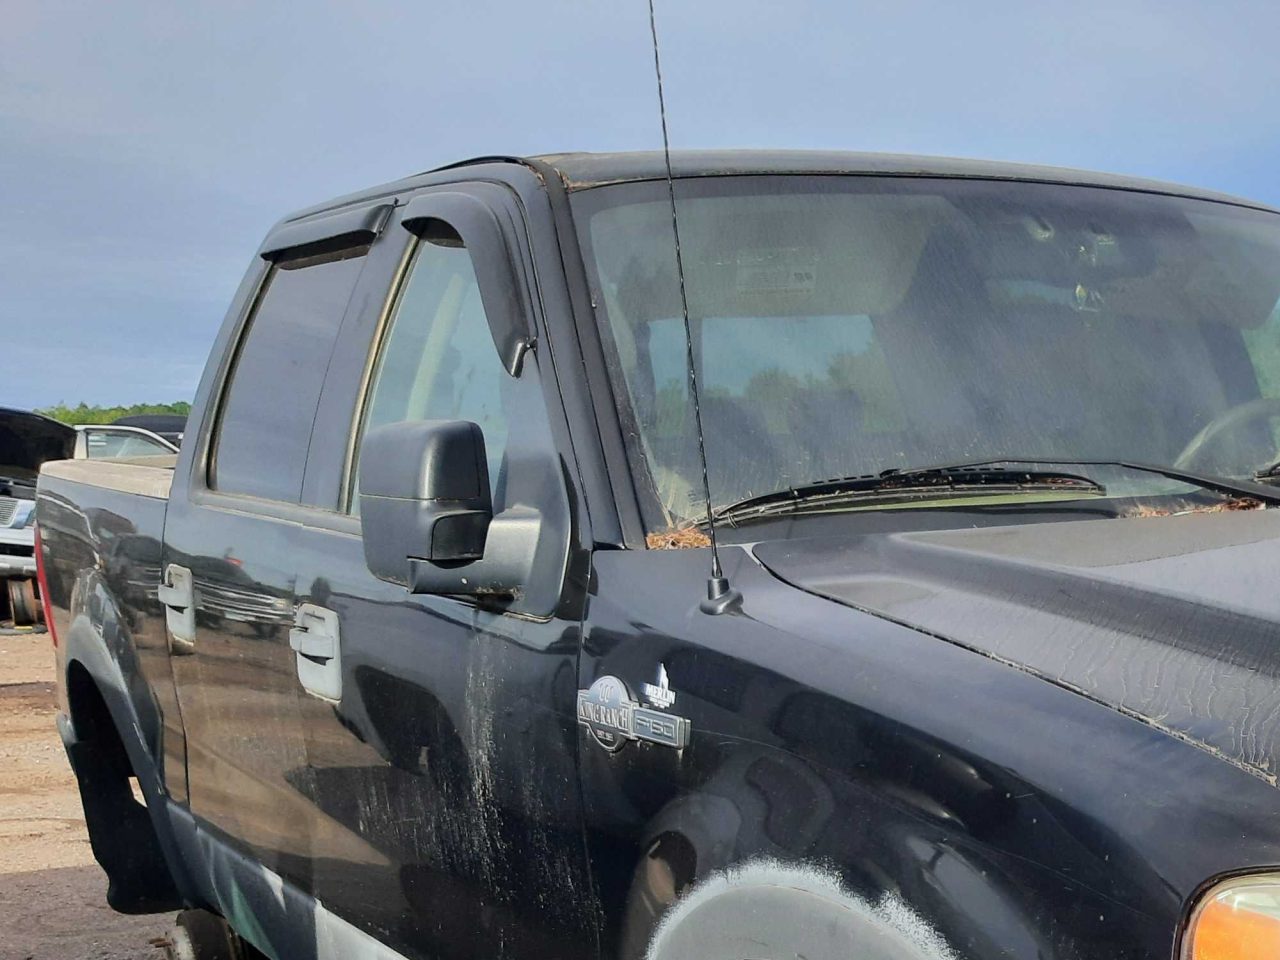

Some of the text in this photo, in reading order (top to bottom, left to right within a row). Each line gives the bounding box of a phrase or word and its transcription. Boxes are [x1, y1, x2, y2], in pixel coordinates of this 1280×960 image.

[644, 683, 676, 705] MERLIN
[579, 697, 630, 731] KING RANCH
